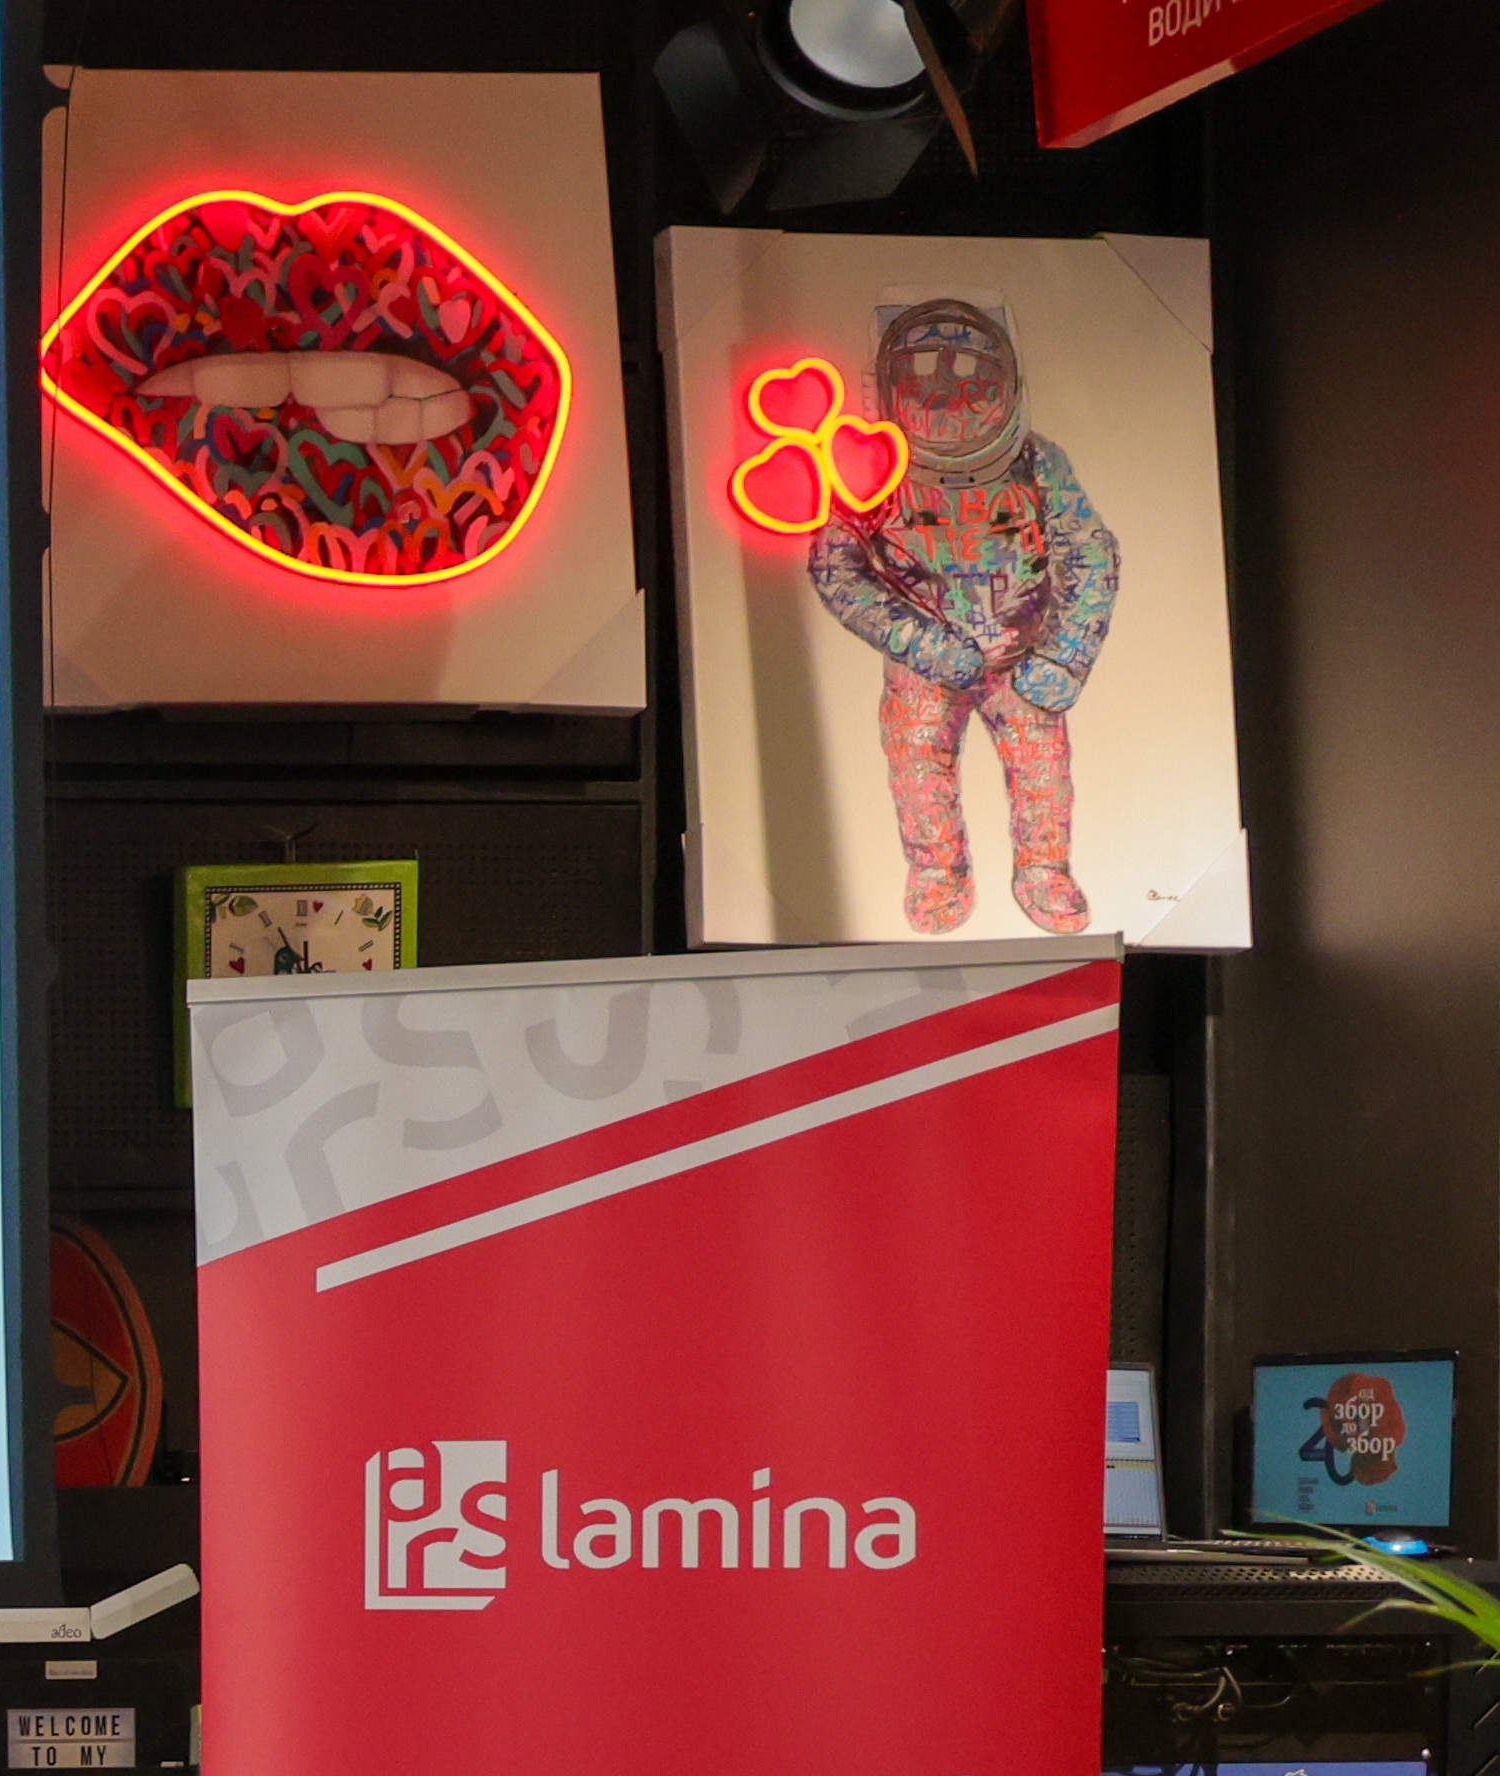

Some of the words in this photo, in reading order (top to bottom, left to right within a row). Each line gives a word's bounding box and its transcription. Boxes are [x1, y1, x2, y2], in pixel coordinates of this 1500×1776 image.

[1148, 0, 1237, 47] ВОД
[1334, 1396, 1385, 1422] збор
[1346, 1434, 1396, 1462] збор
[541, 1466, 918, 1570] lamina
[18, 1715, 122, 1737] WELCOME
[32, 1746, 57, 1767] TO
[80, 1746, 107, 1767] MY
